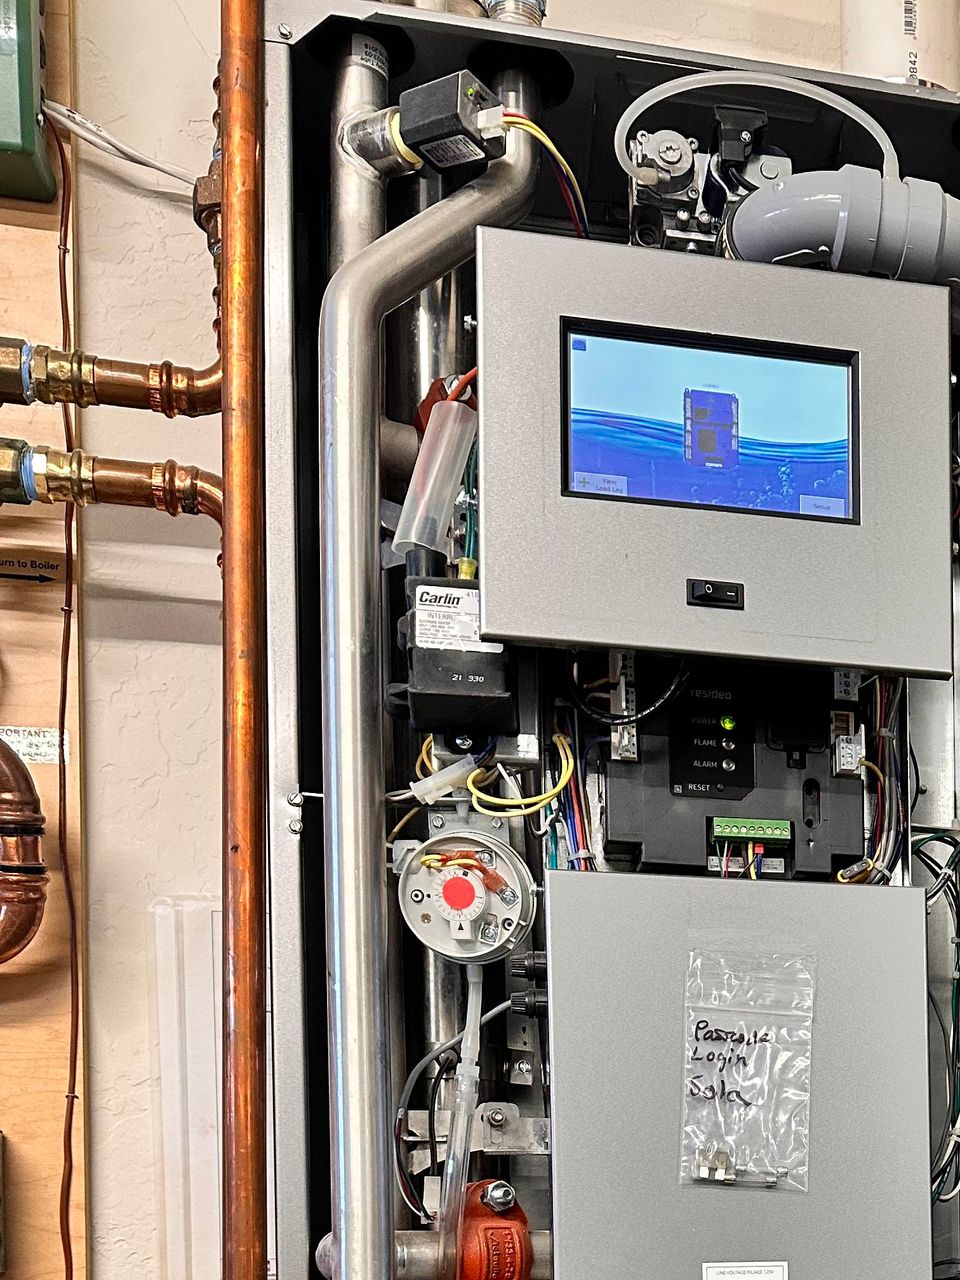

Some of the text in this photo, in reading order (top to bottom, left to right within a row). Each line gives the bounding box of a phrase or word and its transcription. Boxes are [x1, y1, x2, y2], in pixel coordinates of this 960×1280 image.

[813, 502, 831, 512] Setup
[17, 560, 28, 568] to
[30, 560, 60, 570] Boiler
[419, 591, 461, 606] Carlin
[690, 689, 732, 700] resideo
[694, 738, 717, 747] FLAME
[693, 760, 718, 768] ALARM
[688, 783, 711, 791] RESET
[691, 1046, 749, 1073] Login
[690, 1075, 753, 1106] Sola
